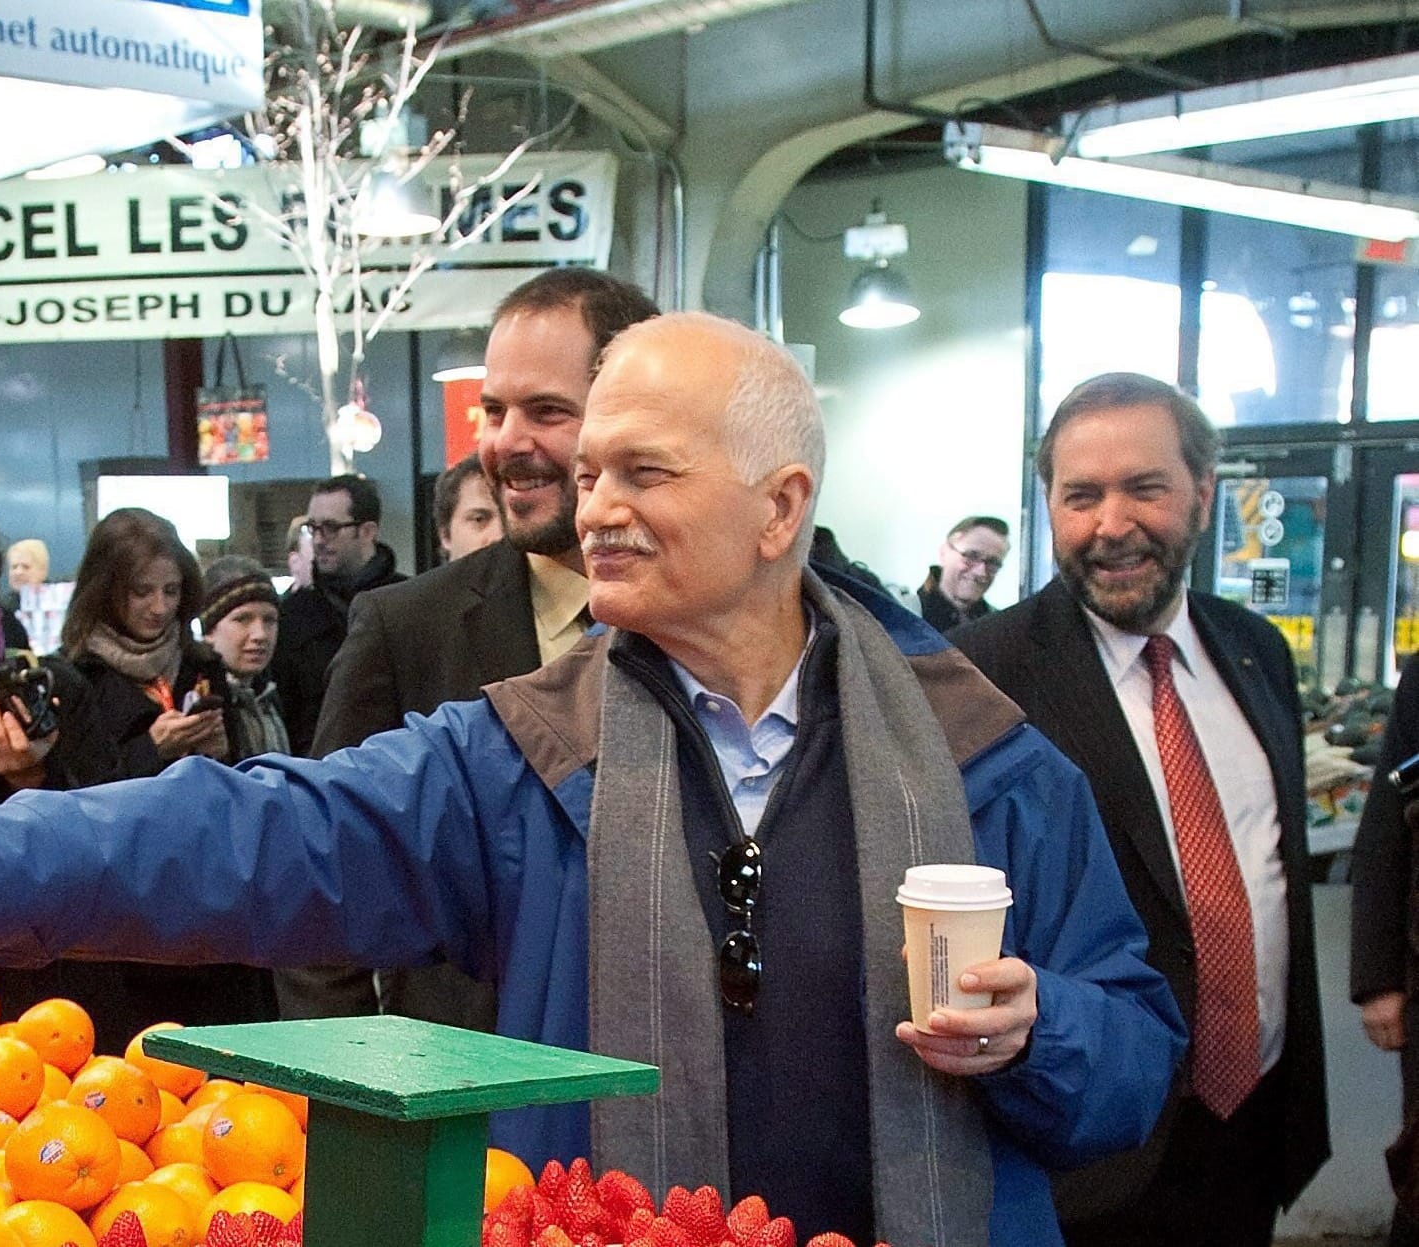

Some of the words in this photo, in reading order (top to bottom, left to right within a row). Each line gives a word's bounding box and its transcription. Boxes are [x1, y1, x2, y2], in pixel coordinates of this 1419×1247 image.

[50, 26, 246, 84] automatique
[129, 192, 250, 254] LES
[224, 288, 291, 319] DU
